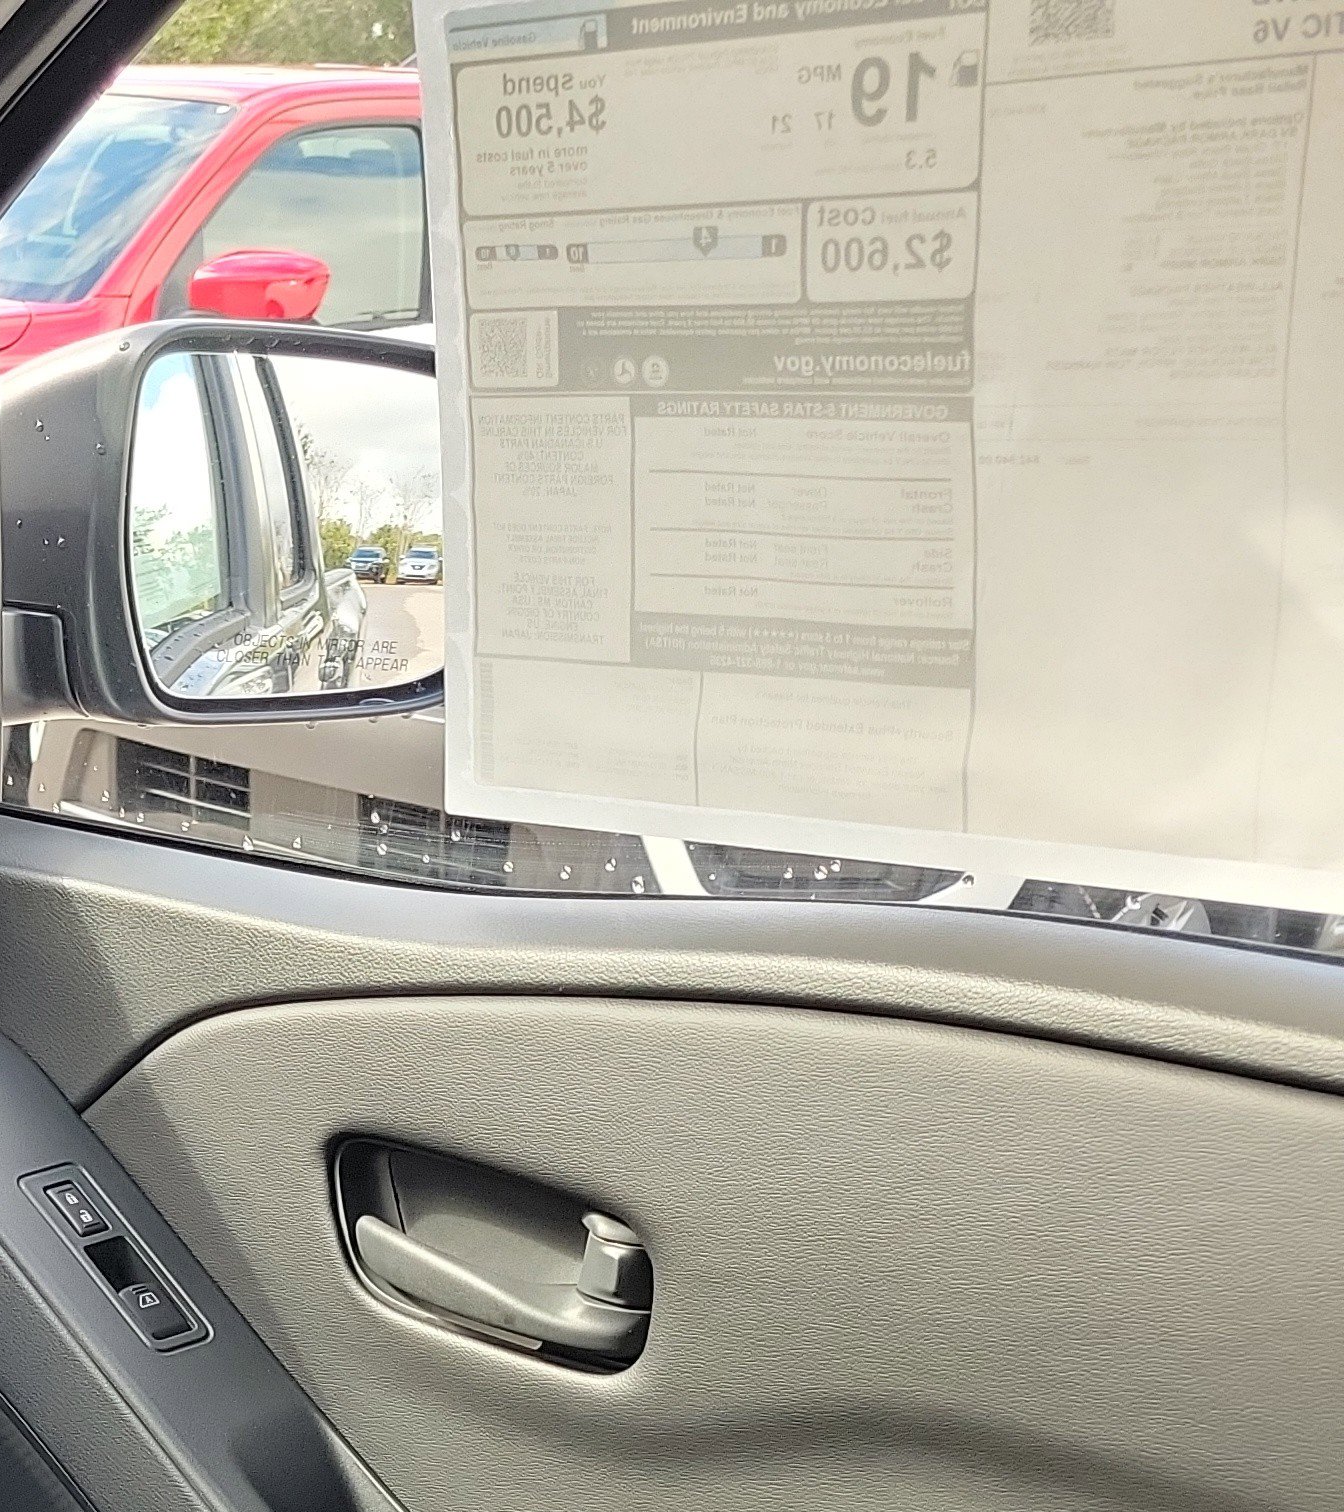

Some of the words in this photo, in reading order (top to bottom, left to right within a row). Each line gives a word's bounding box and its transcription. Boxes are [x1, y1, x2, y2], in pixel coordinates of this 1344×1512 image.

[234, 633, 295, 648] OBJECTS
[371, 640, 398, 655] ARE
[216, 650, 269, 664] CLOSER
[276, 652, 311, 666] THAN
[355, 657, 409, 672] APPEAR
